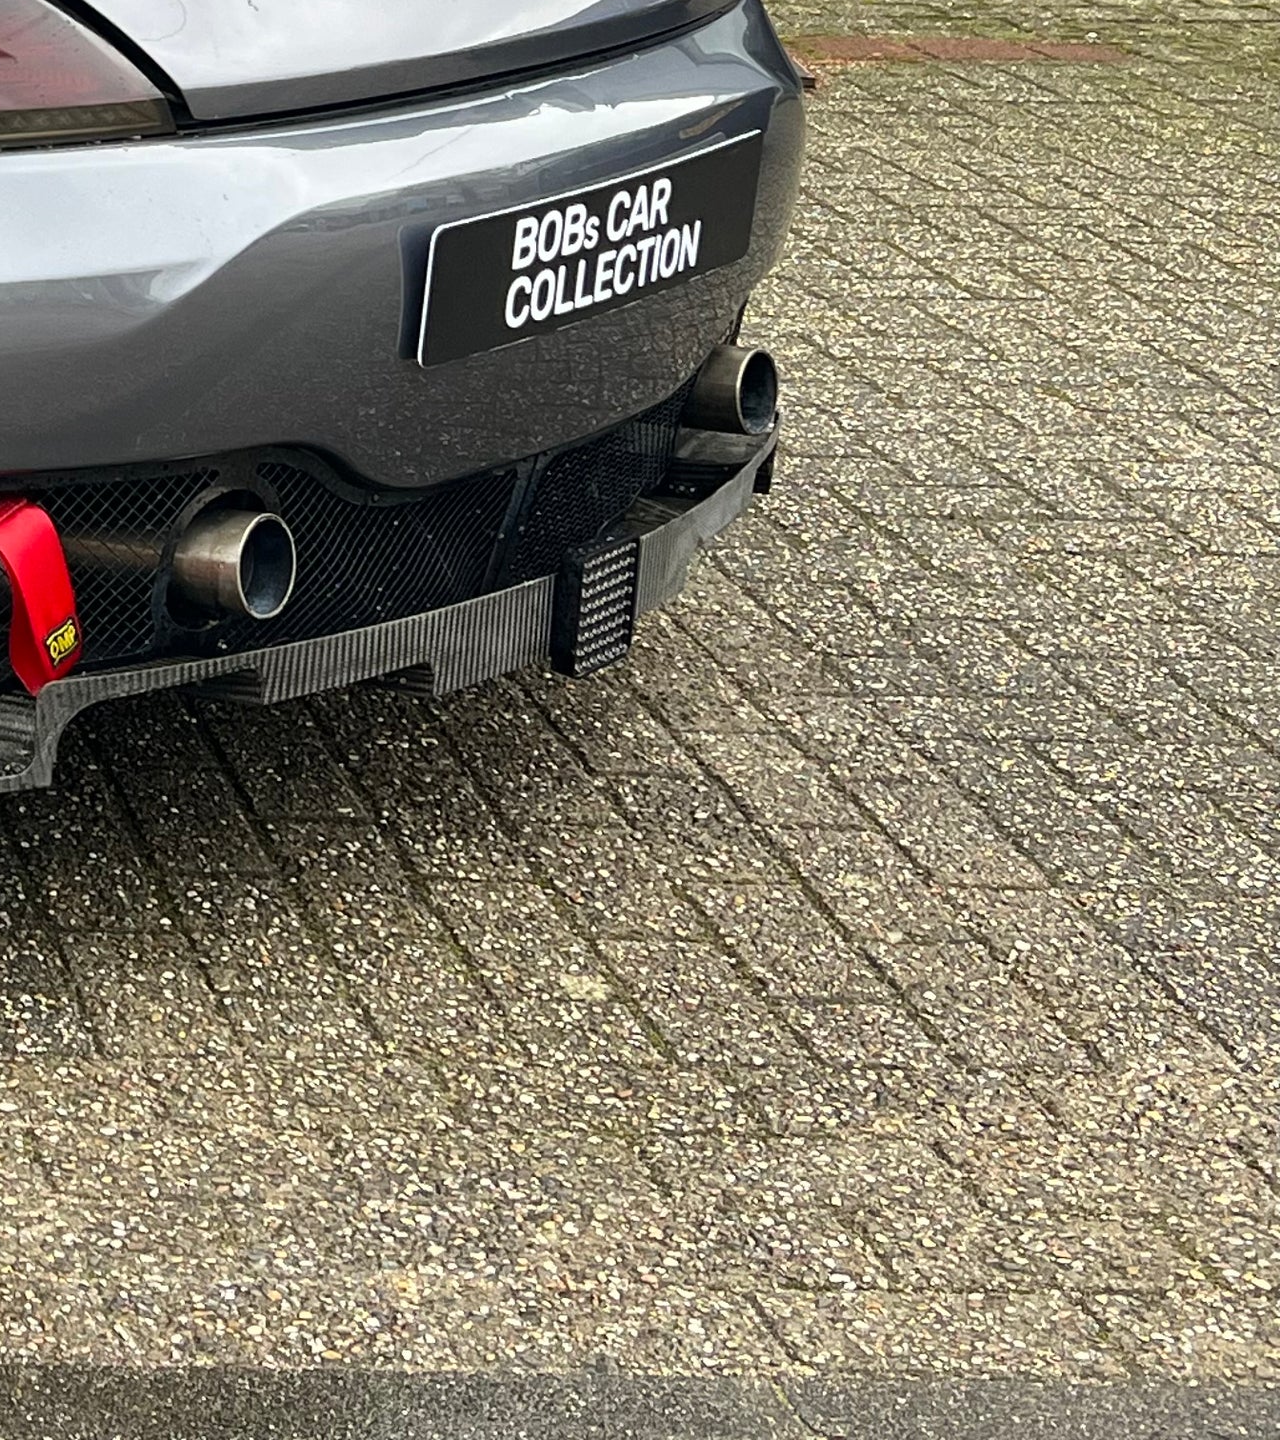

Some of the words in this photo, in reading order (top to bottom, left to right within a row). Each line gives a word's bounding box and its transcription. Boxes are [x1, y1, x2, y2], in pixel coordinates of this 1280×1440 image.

[512, 202, 599, 270] BOBs
[606, 177, 672, 243] CAR
[504, 219, 702, 329] COLLECTION
[50, 625, 76, 659] OMP
